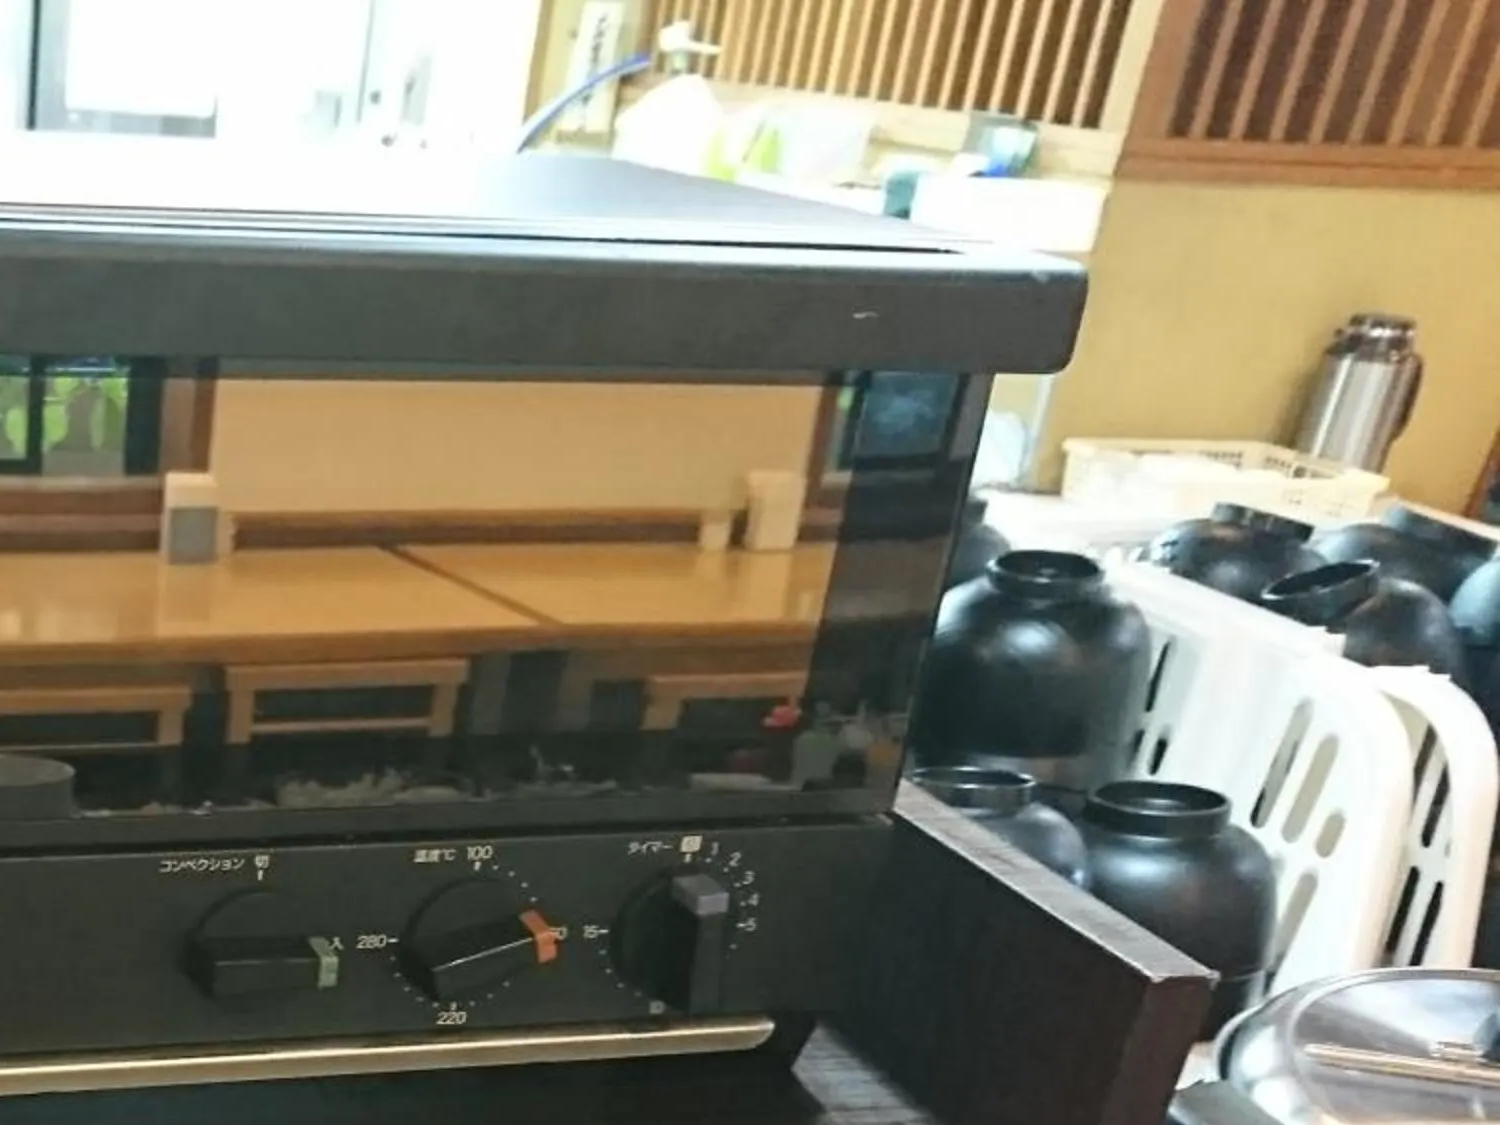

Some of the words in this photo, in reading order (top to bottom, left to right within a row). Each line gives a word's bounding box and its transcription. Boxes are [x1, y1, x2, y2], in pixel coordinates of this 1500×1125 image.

[467, 845, 493, 860] 100
[729, 851, 742, 867] 2
[159, 858, 245, 873] コンベクション
[742, 870, 755, 885] 3
[747, 893, 759, 906] 4
[744, 917, 757, 932] 5
[356, 933, 388, 949] 280
[435, 1010, 468, 1025] 220
